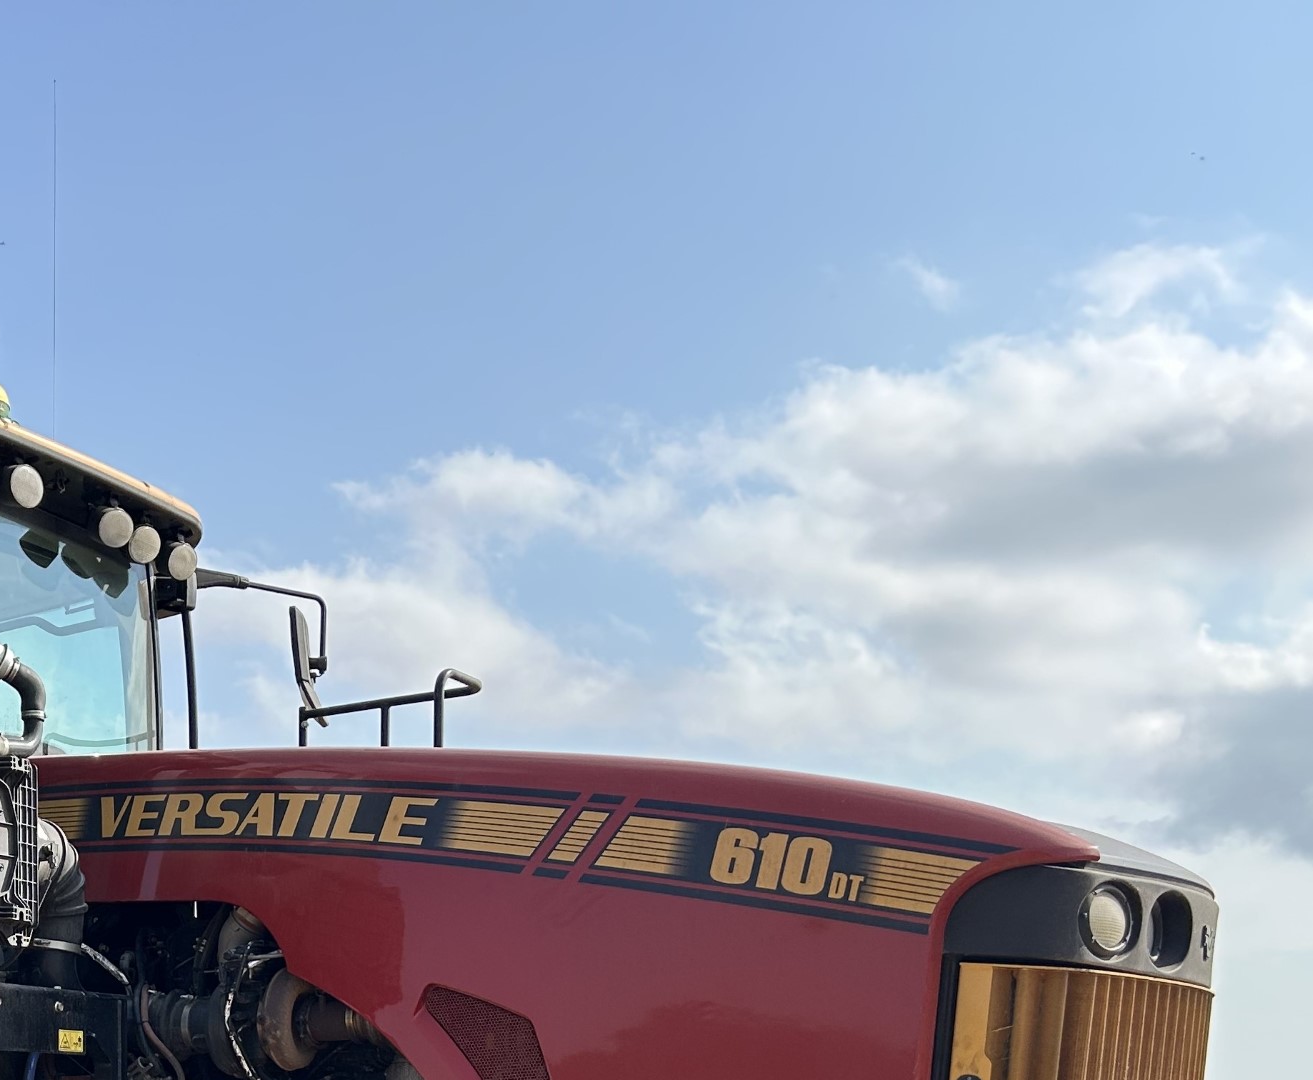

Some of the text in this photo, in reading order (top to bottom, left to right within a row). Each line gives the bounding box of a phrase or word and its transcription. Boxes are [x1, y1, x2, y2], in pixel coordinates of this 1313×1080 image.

[100, 792, 439, 846] VERSATILE
[709, 827, 865, 902] 610 DT
